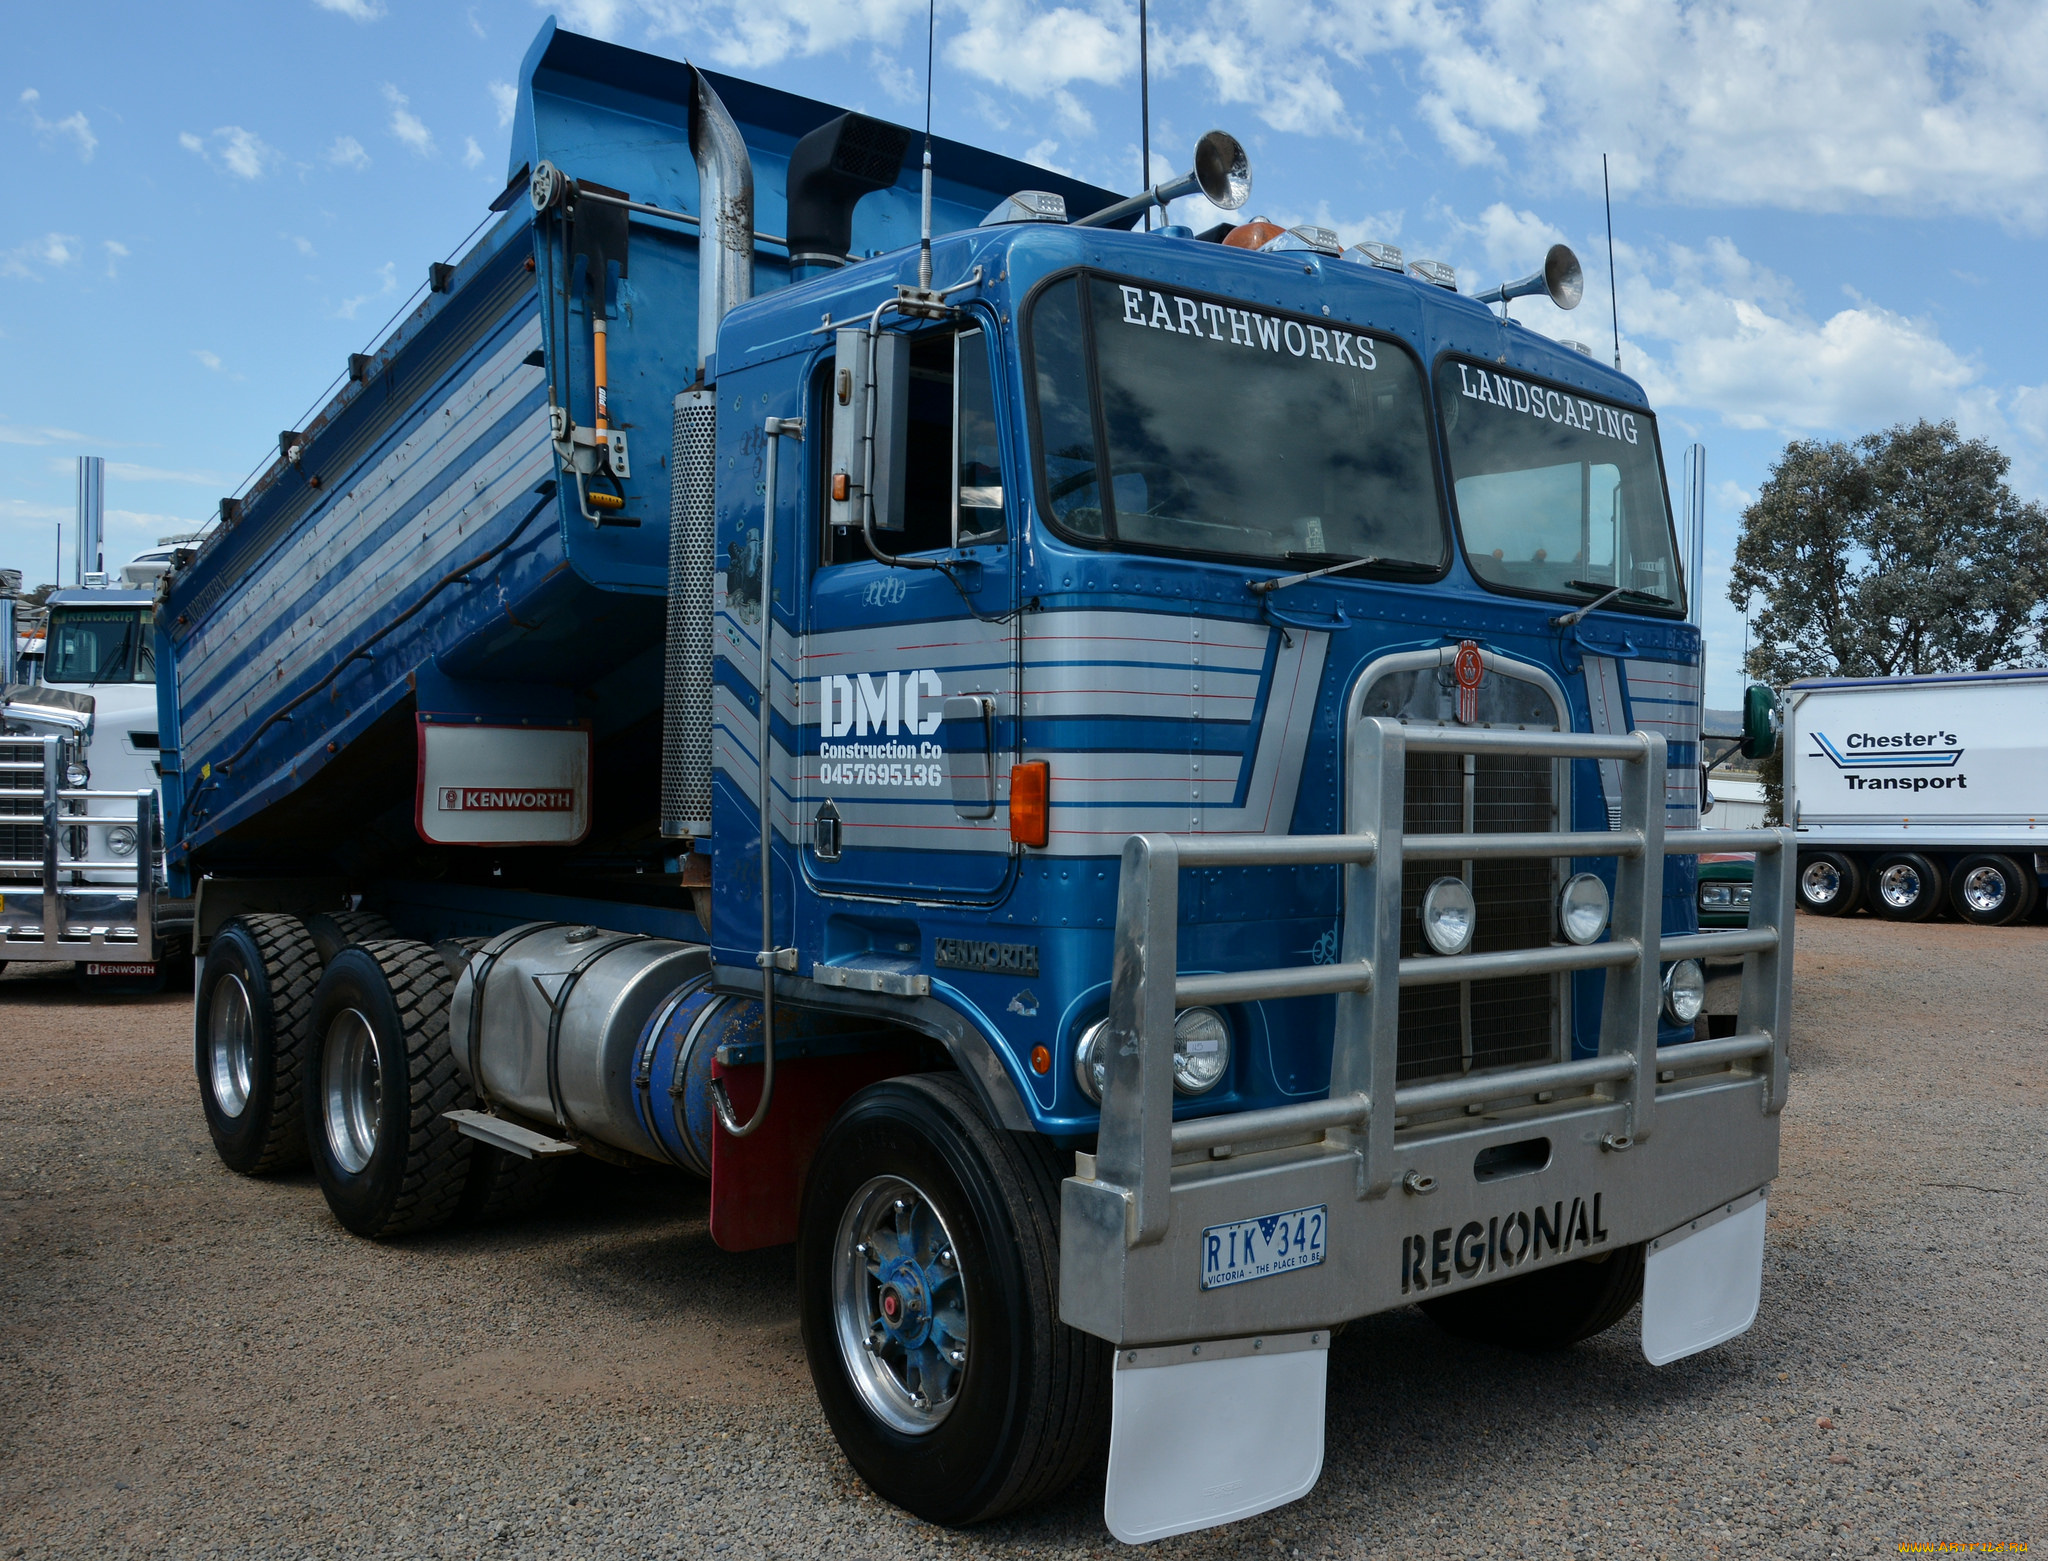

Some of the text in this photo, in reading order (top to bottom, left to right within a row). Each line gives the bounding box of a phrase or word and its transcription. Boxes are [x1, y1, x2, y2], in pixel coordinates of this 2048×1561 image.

[1119, 284, 1377, 371] EARTHWORKS
[1457, 363, 1638, 445] LANDSCAPING
[185, 570, 228, 625] NORTHERN
[68, 611, 134, 622] KENWORTH
[820, 669, 943, 737] DMC
[820, 739, 943, 760] Construction Co
[1846, 731, 1958, 749] Chester's
[820, 763, 943, 787] 0457695136
[1843, 773, 1968, 793] Transport
[466, 792, 571, 808] KENWORTH
[100, 965, 156, 975] KENWORTH
[935, 937, 1040, 971] KENWORTH
[1207, 1213, 1322, 1273] RIK 342
[1401, 1192, 1609, 1295] REGIONAL
[1208, 1269, 1245, 1285] VICTORIA
[1256, 1263, 1270, 1275] THE
[1273, 1257, 1296, 1271] PLACE
[1298, 1255, 1308, 1264] TO
[1311, 1251, 1320, 1262] BE
